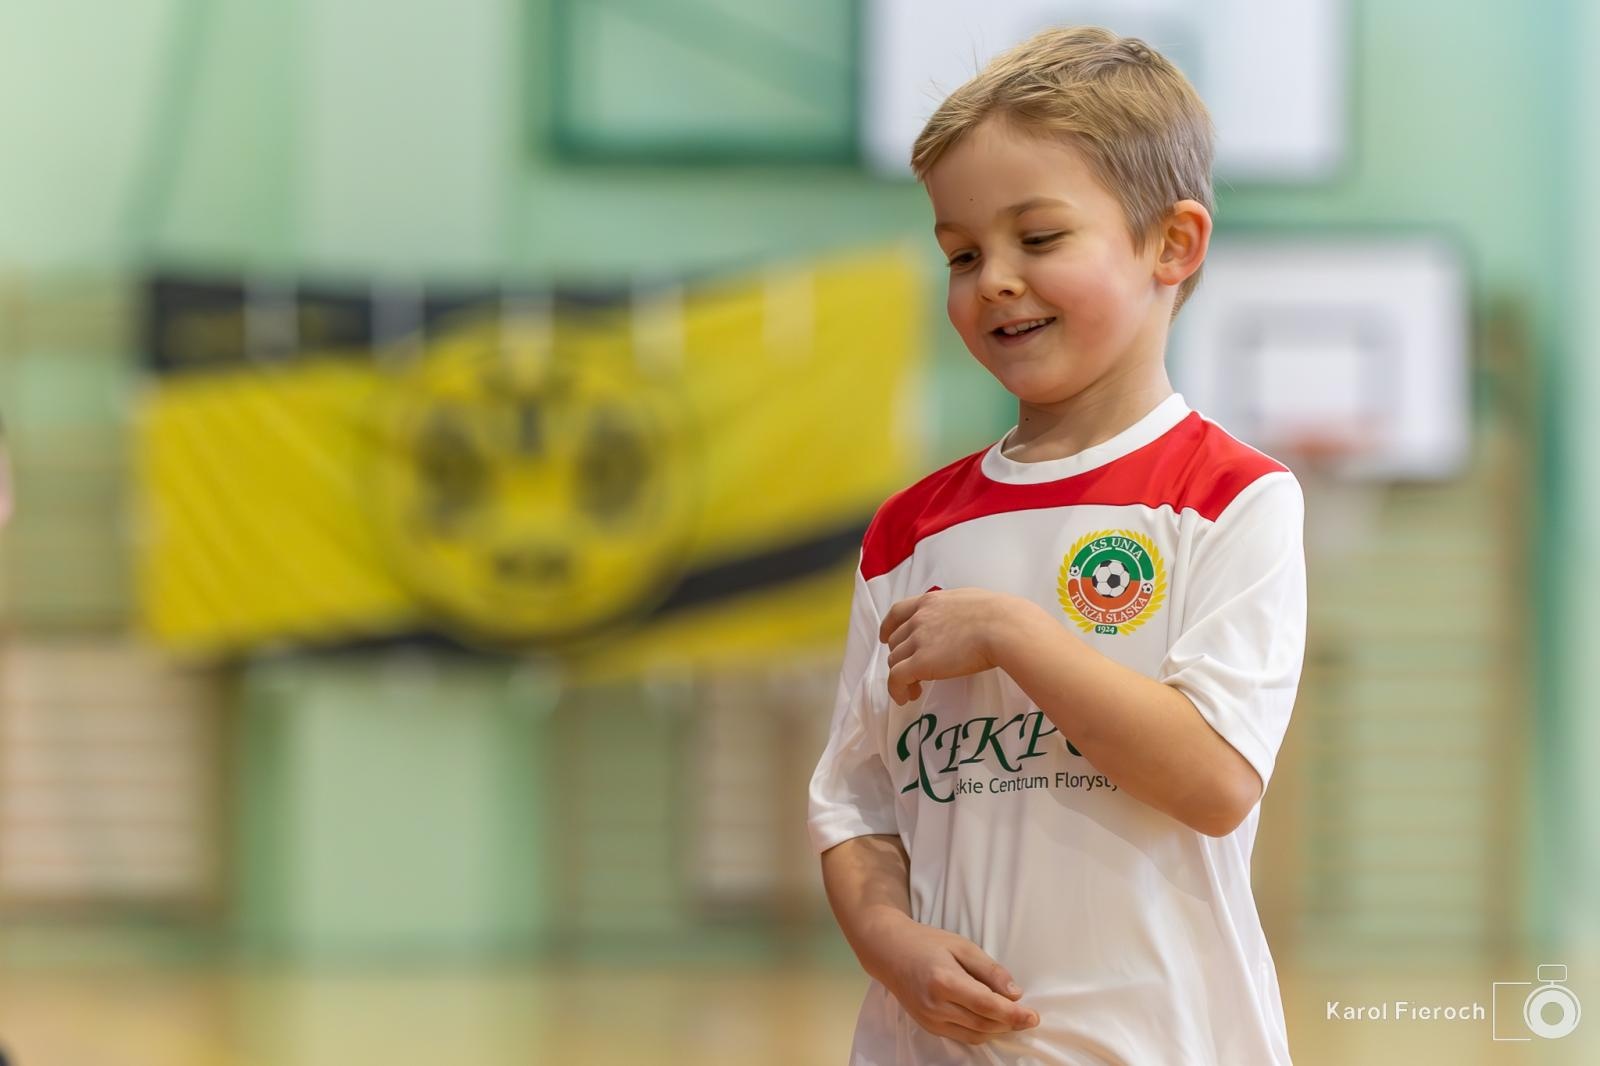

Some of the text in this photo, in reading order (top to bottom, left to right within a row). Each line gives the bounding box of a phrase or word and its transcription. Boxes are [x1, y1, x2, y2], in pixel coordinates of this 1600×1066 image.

[1089, 538, 1143, 560] KS UNIA
[1071, 591, 1103, 623] TURZA
[1097, 625, 1115, 634] 1924
[896, 711, 1083, 803] REKP
[989, 775, 1049, 794] Centrum
[1055, 772, 1118, 792] Floryst
